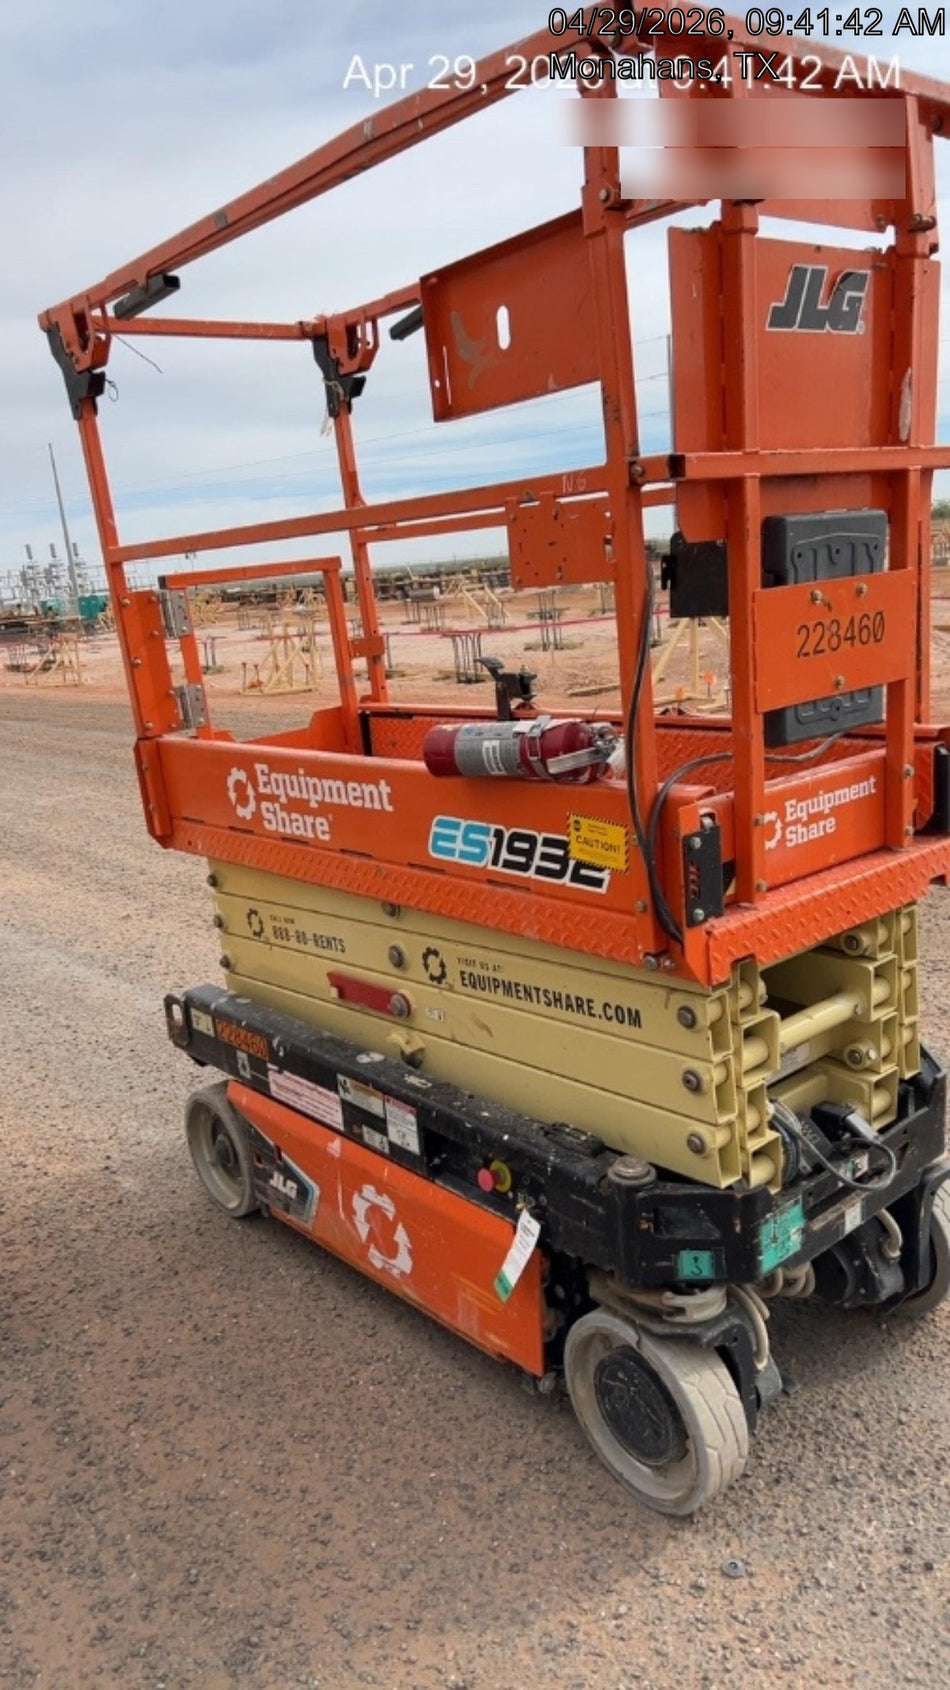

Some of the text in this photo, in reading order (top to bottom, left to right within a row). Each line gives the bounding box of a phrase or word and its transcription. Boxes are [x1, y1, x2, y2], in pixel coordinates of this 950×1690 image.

[766, 264, 872, 335] JLG
[797, 610, 885, 658] 228460
[254, 763, 394, 812] Equipment
[785, 776, 877, 823] Equipment
[260, 801, 332, 841] Share
[786, 816, 837, 848] Share
[459, 970, 643, 1028] EQUIPMENTSHARE.COM
[270, 1170, 298, 1199] JLG
